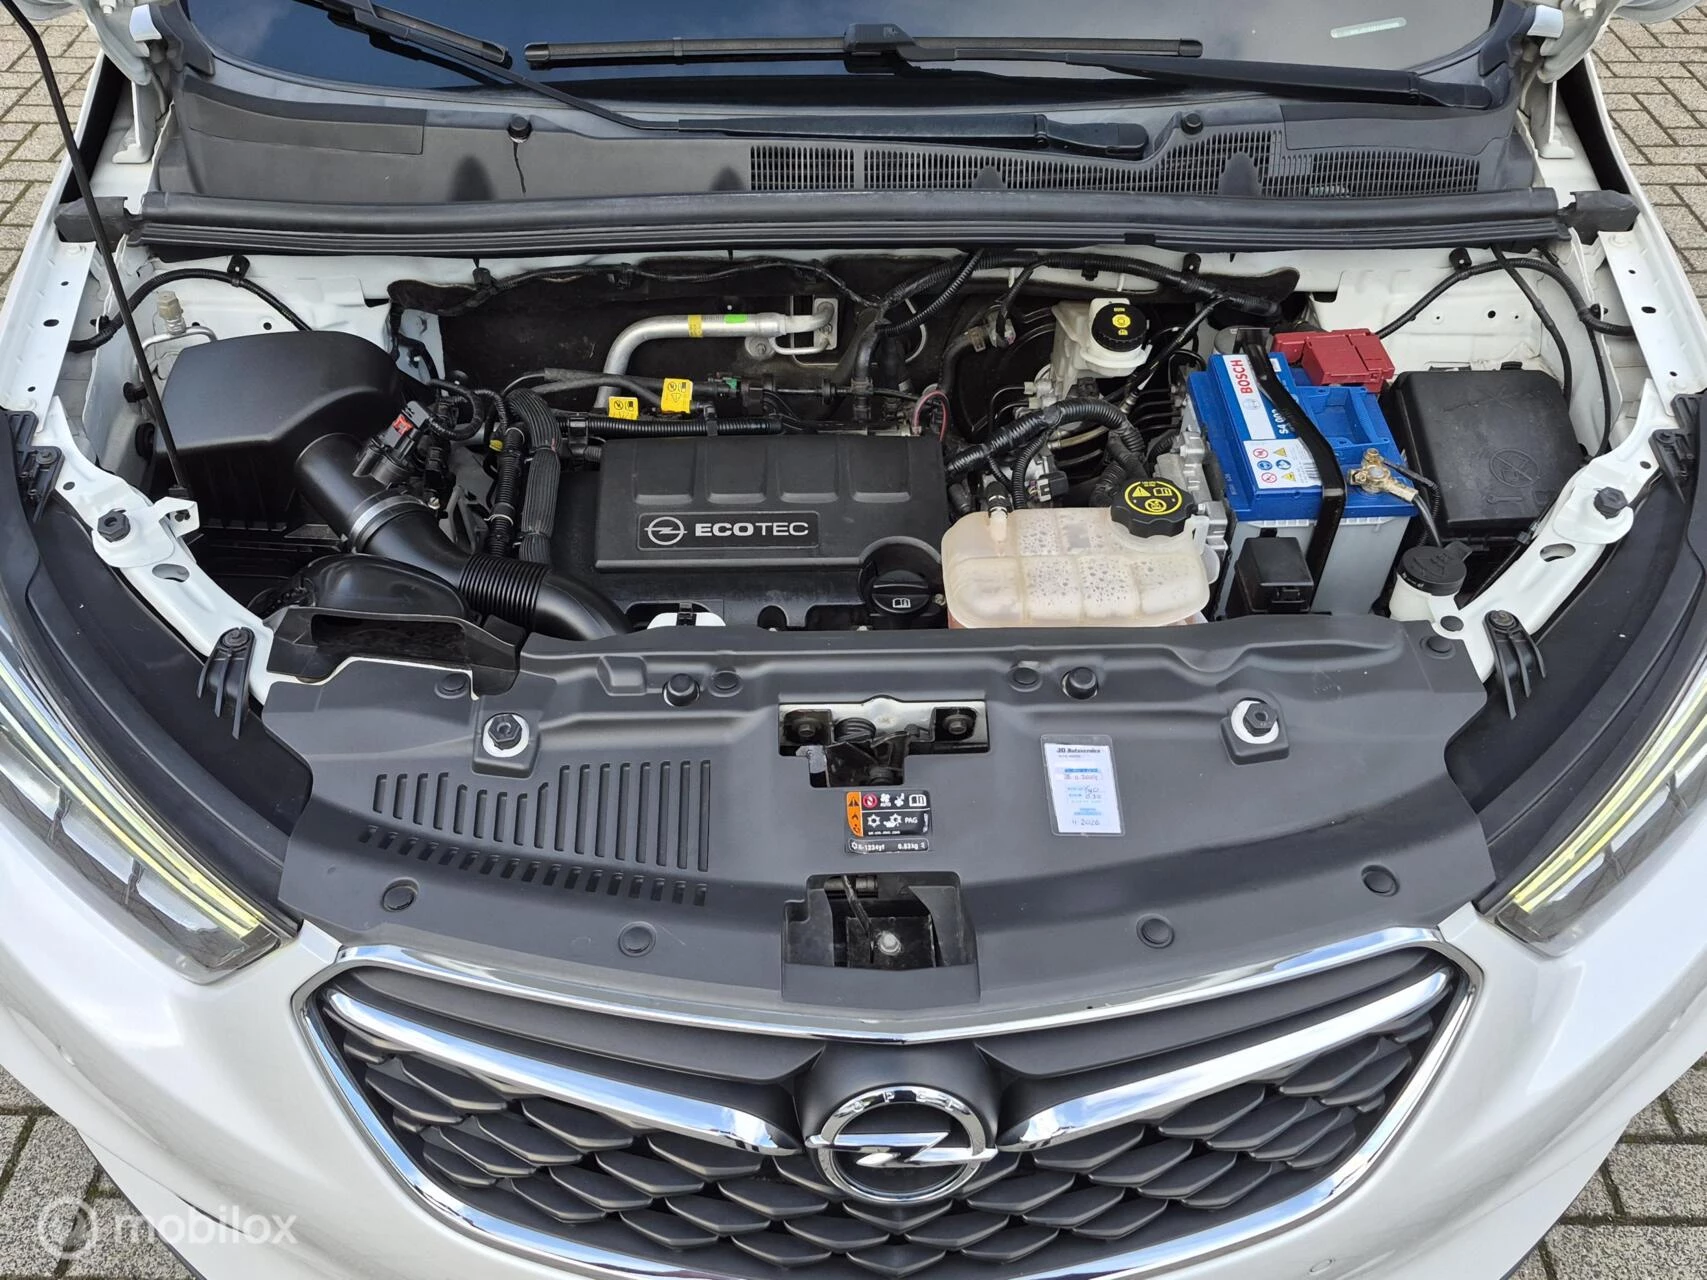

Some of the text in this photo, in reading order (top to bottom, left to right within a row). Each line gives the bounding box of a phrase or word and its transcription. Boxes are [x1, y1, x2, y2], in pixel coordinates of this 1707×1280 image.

[1230, 359, 1254, 394] BOSCH
[695, 522, 809, 537] ECOTEC
[904, 816, 918, 824] PAG
